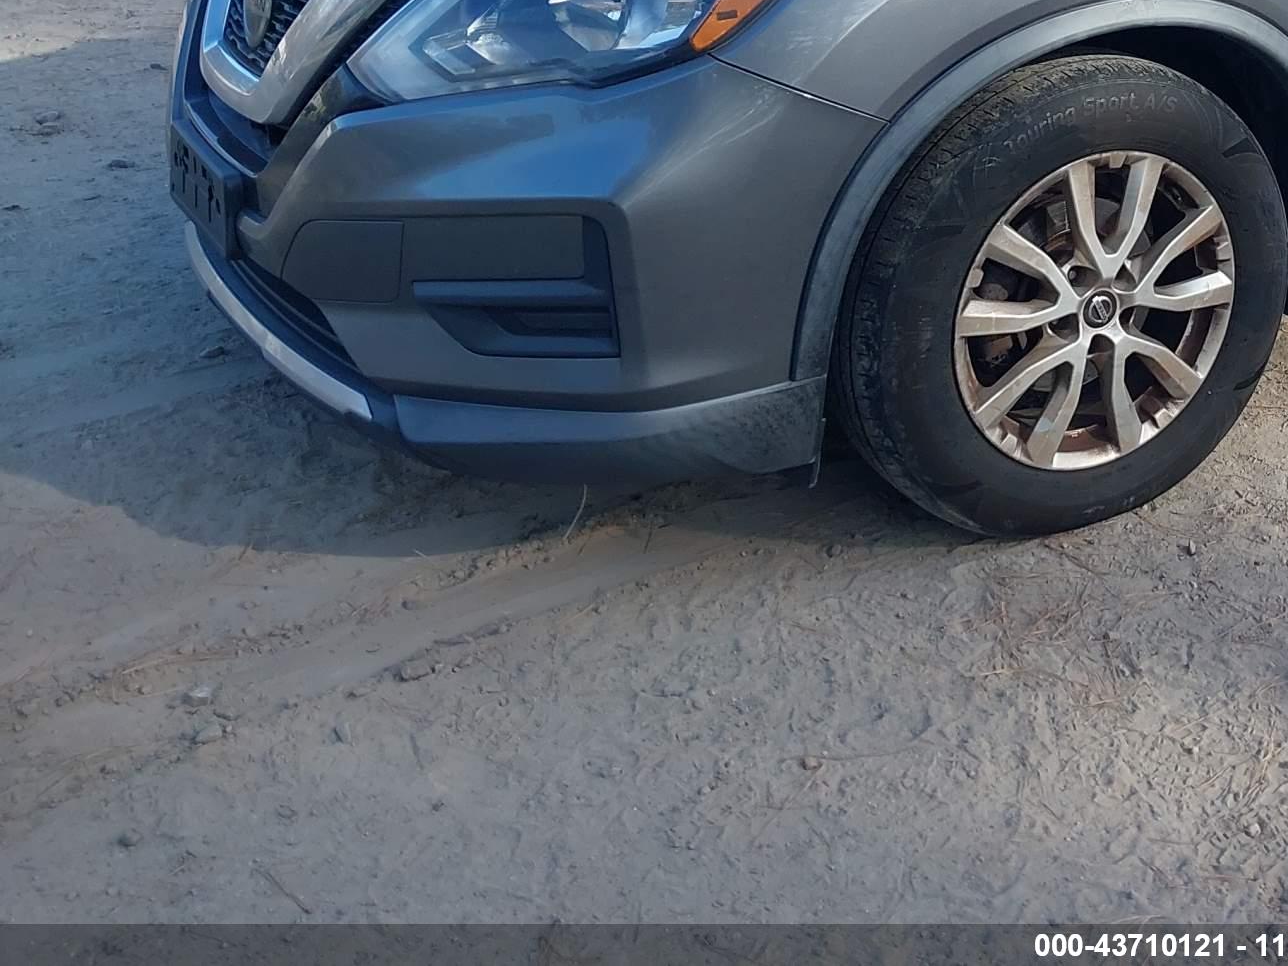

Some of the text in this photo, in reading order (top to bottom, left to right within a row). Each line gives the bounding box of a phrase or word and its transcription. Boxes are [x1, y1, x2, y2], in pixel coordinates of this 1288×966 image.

[1003, 91, 1178, 154] Touring Sport A/S
